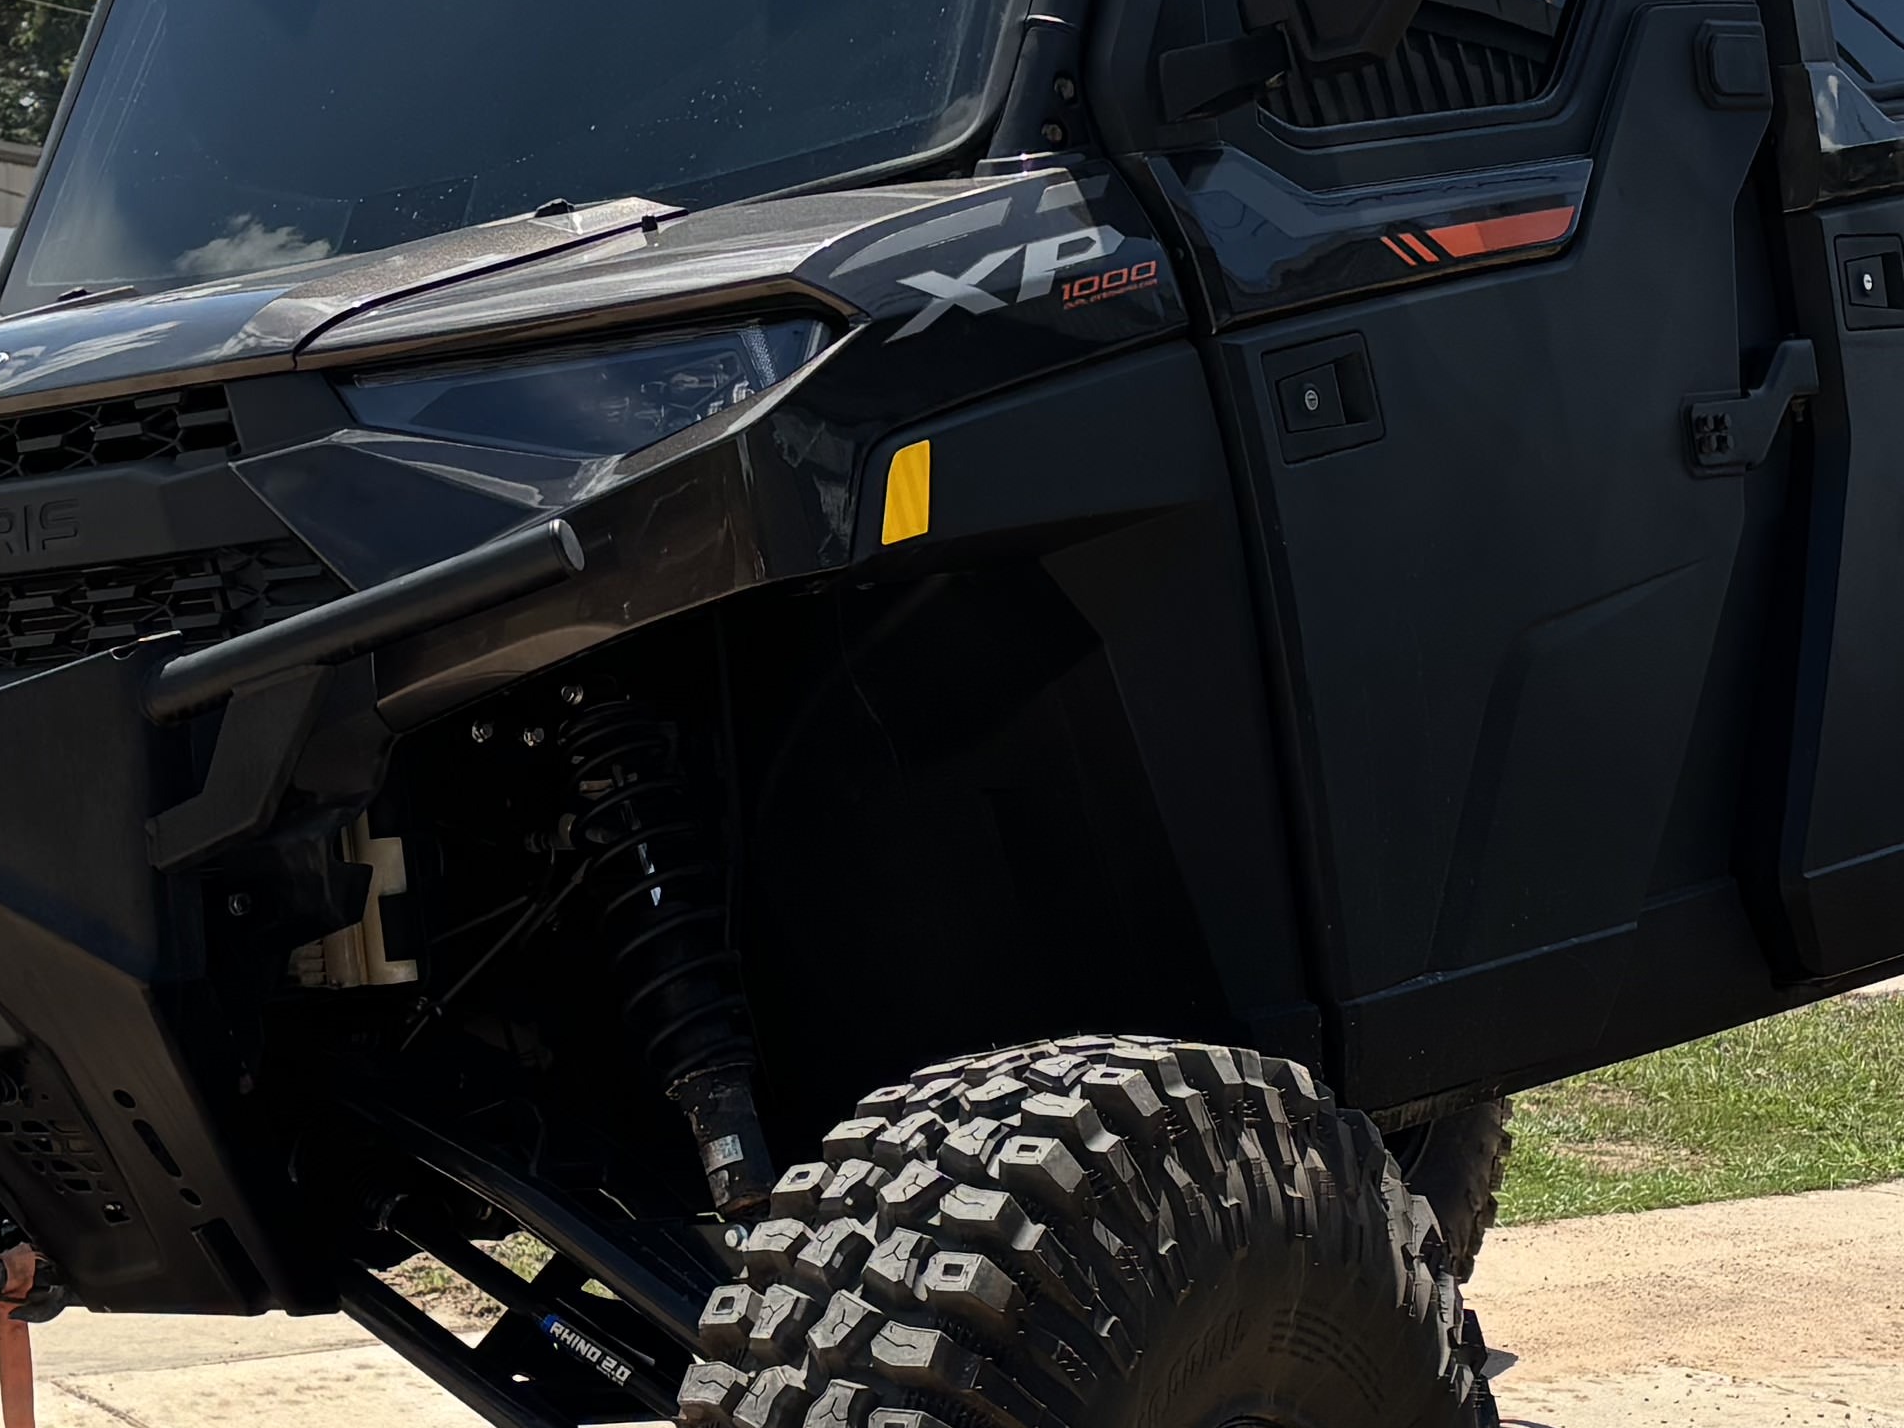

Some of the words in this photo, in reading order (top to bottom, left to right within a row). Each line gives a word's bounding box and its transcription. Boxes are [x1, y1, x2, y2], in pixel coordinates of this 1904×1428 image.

[883, 224, 1126, 344] XP
[1062, 260, 1157, 302] 1000
[549, 1321, 602, 1363] RHINO
[601, 1356, 632, 1382] 2.0
